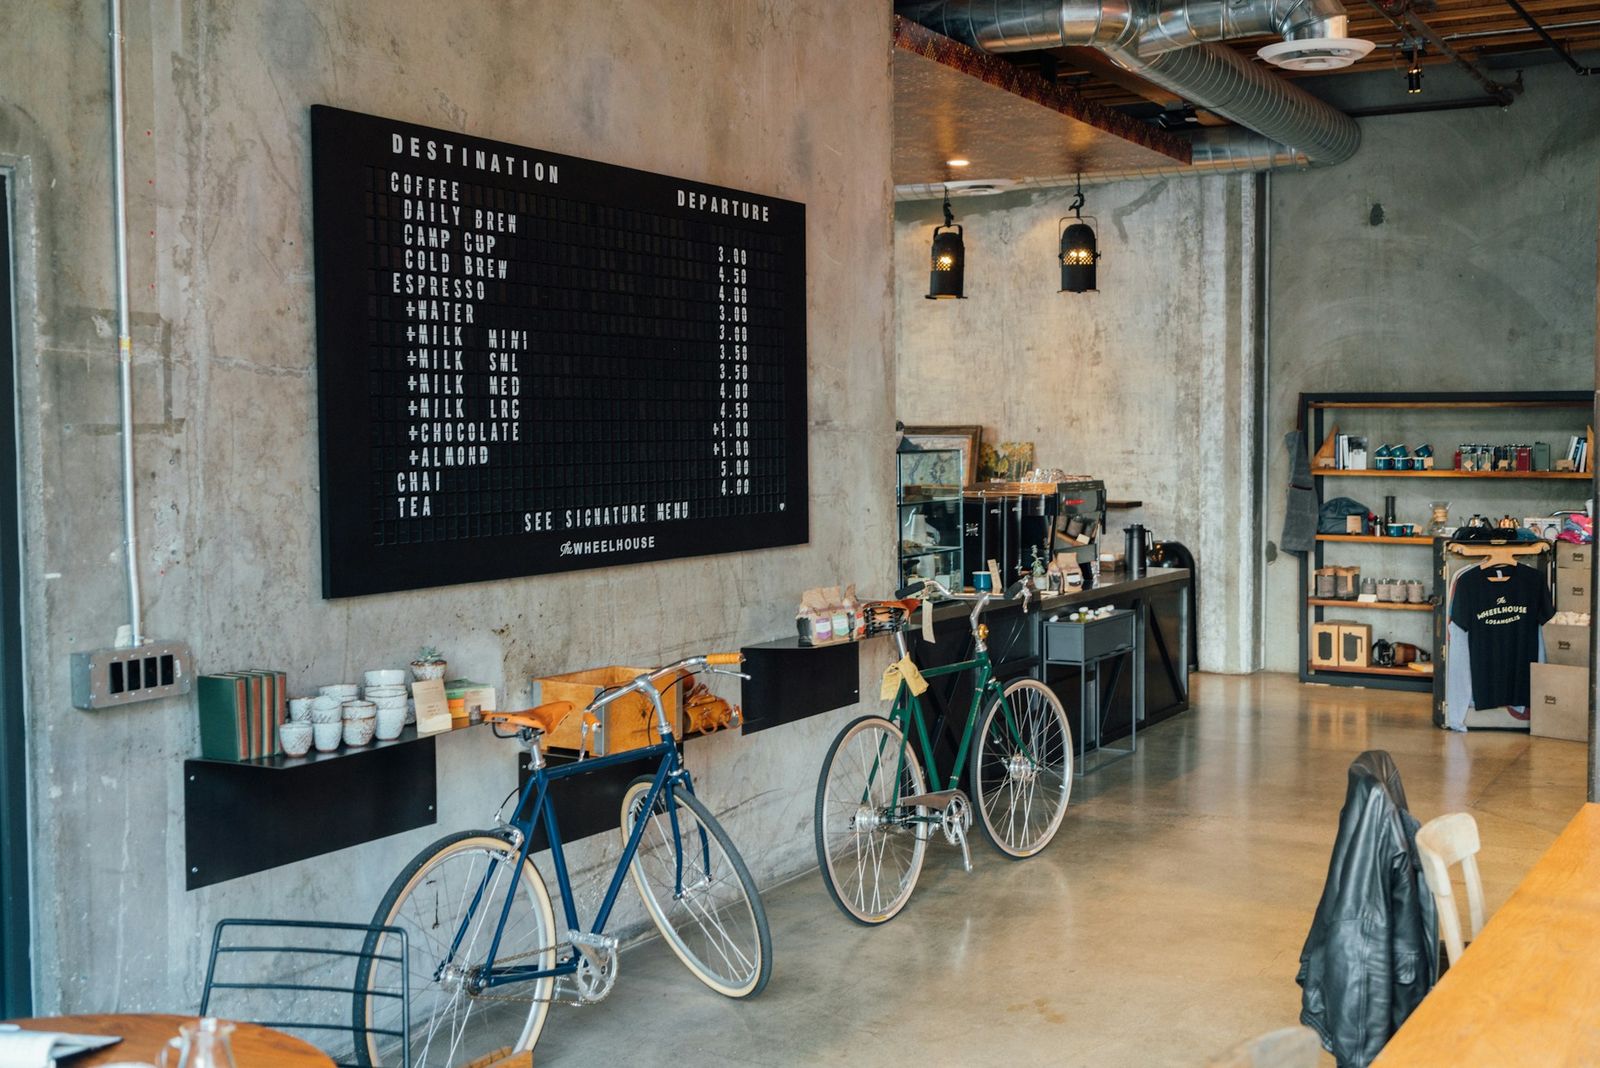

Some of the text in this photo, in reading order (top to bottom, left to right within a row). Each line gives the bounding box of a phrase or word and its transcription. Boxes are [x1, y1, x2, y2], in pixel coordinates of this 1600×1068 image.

[392, 133, 559, 184] DESTINATION
[391, 172, 459, 201] COFFEE
[677, 189, 769, 222] DEPARTURE
[404, 199, 516, 234] DAILY BREW
[404, 224, 496, 254] CAMP CUP
[405, 249, 508, 280] COLD BREW
[718, 246, 747, 266] 3.00
[718, 267, 747, 285] 4.50
[393, 272, 485, 301] ESPRESSO
[718, 286, 747, 304] 4.00
[719, 305, 748, 323] 3.00
[488, 330, 527, 350] MINI
[719, 325, 748, 342] 3.00
[489, 353, 518, 372] SML
[719, 344, 748, 361] 3.50
[719, 364, 748, 380] 3.50
[489, 376, 520, 396] MED
[719, 383, 748, 400] 4.00
[490, 399, 520, 420] LRG
[720, 403, 748, 419] 4.50
[721, 460, 749, 477] 5.00
[397, 472, 440, 493] CHAI
[721, 479, 750, 496] 4.00
[397, 496, 431, 518] TEA
[525, 502, 688, 531] SEE SIGNATURE MENU
[572, 536, 655, 555] WHEELHOUSE
[1477, 605, 1527, 620] WHEELHOUSE
